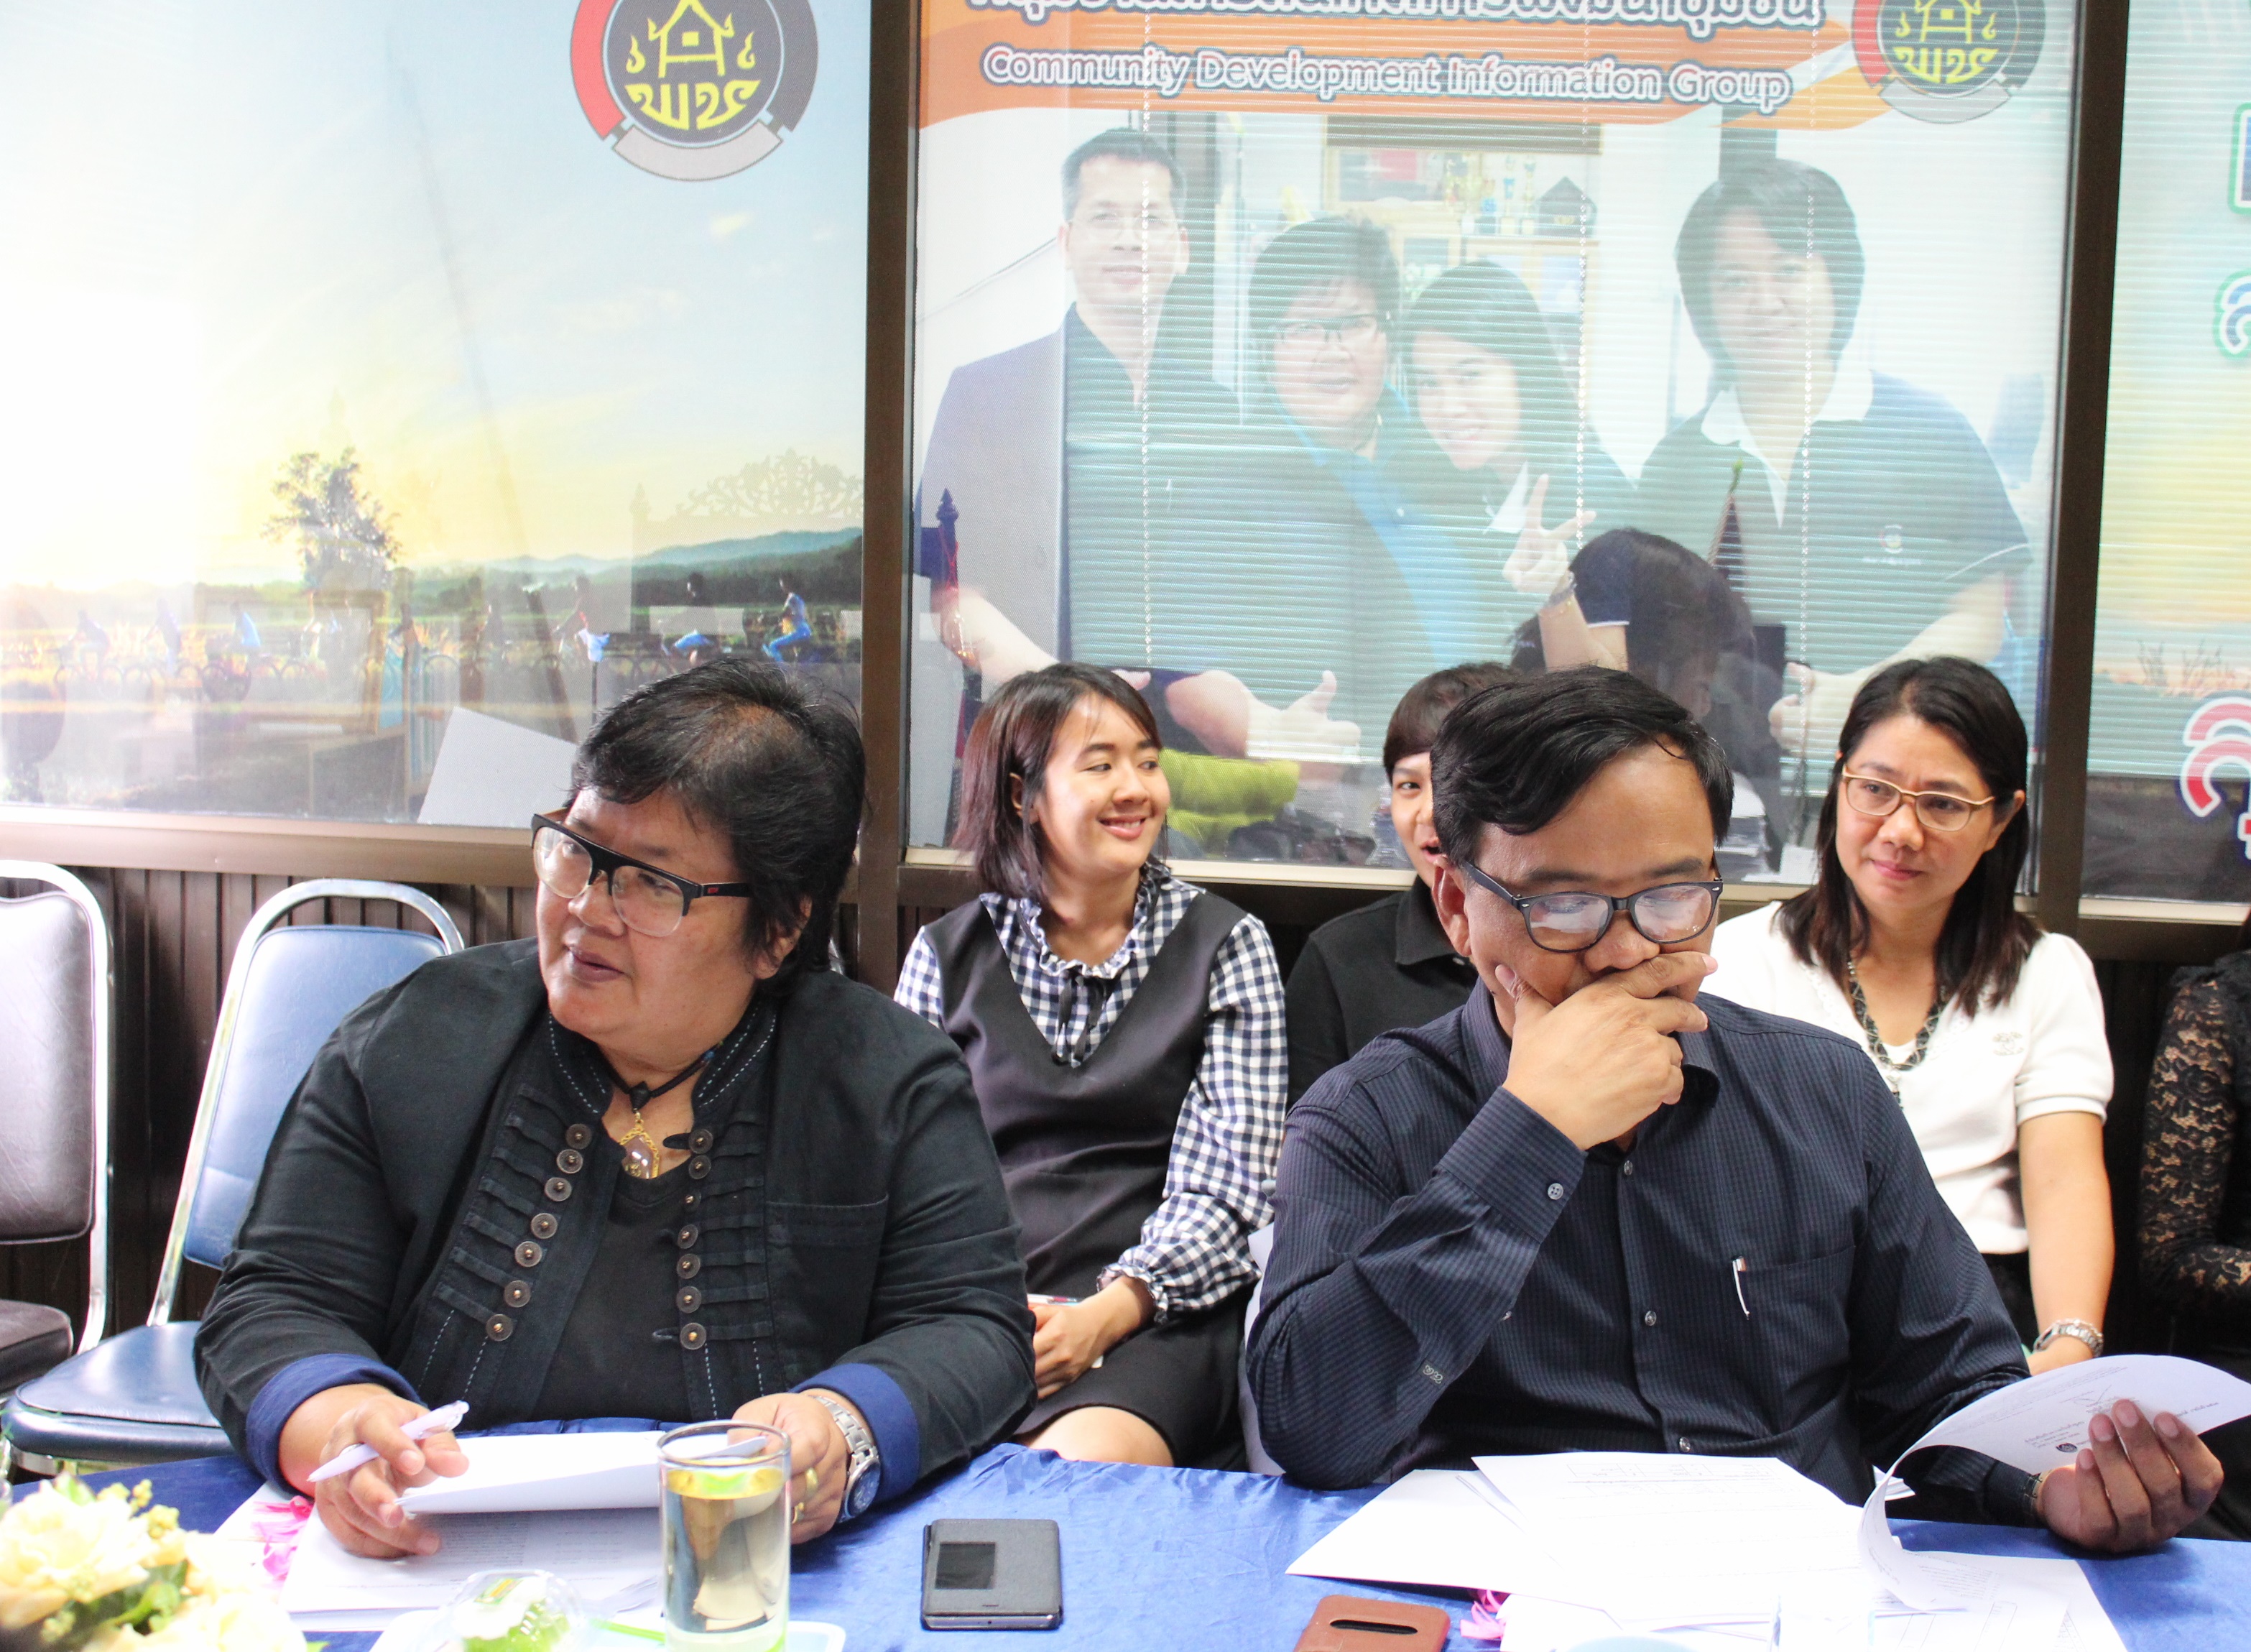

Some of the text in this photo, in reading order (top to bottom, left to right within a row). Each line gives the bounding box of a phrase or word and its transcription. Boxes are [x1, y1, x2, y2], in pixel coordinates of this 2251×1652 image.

[982, 45, 1794, 114] Community Development Information Group
